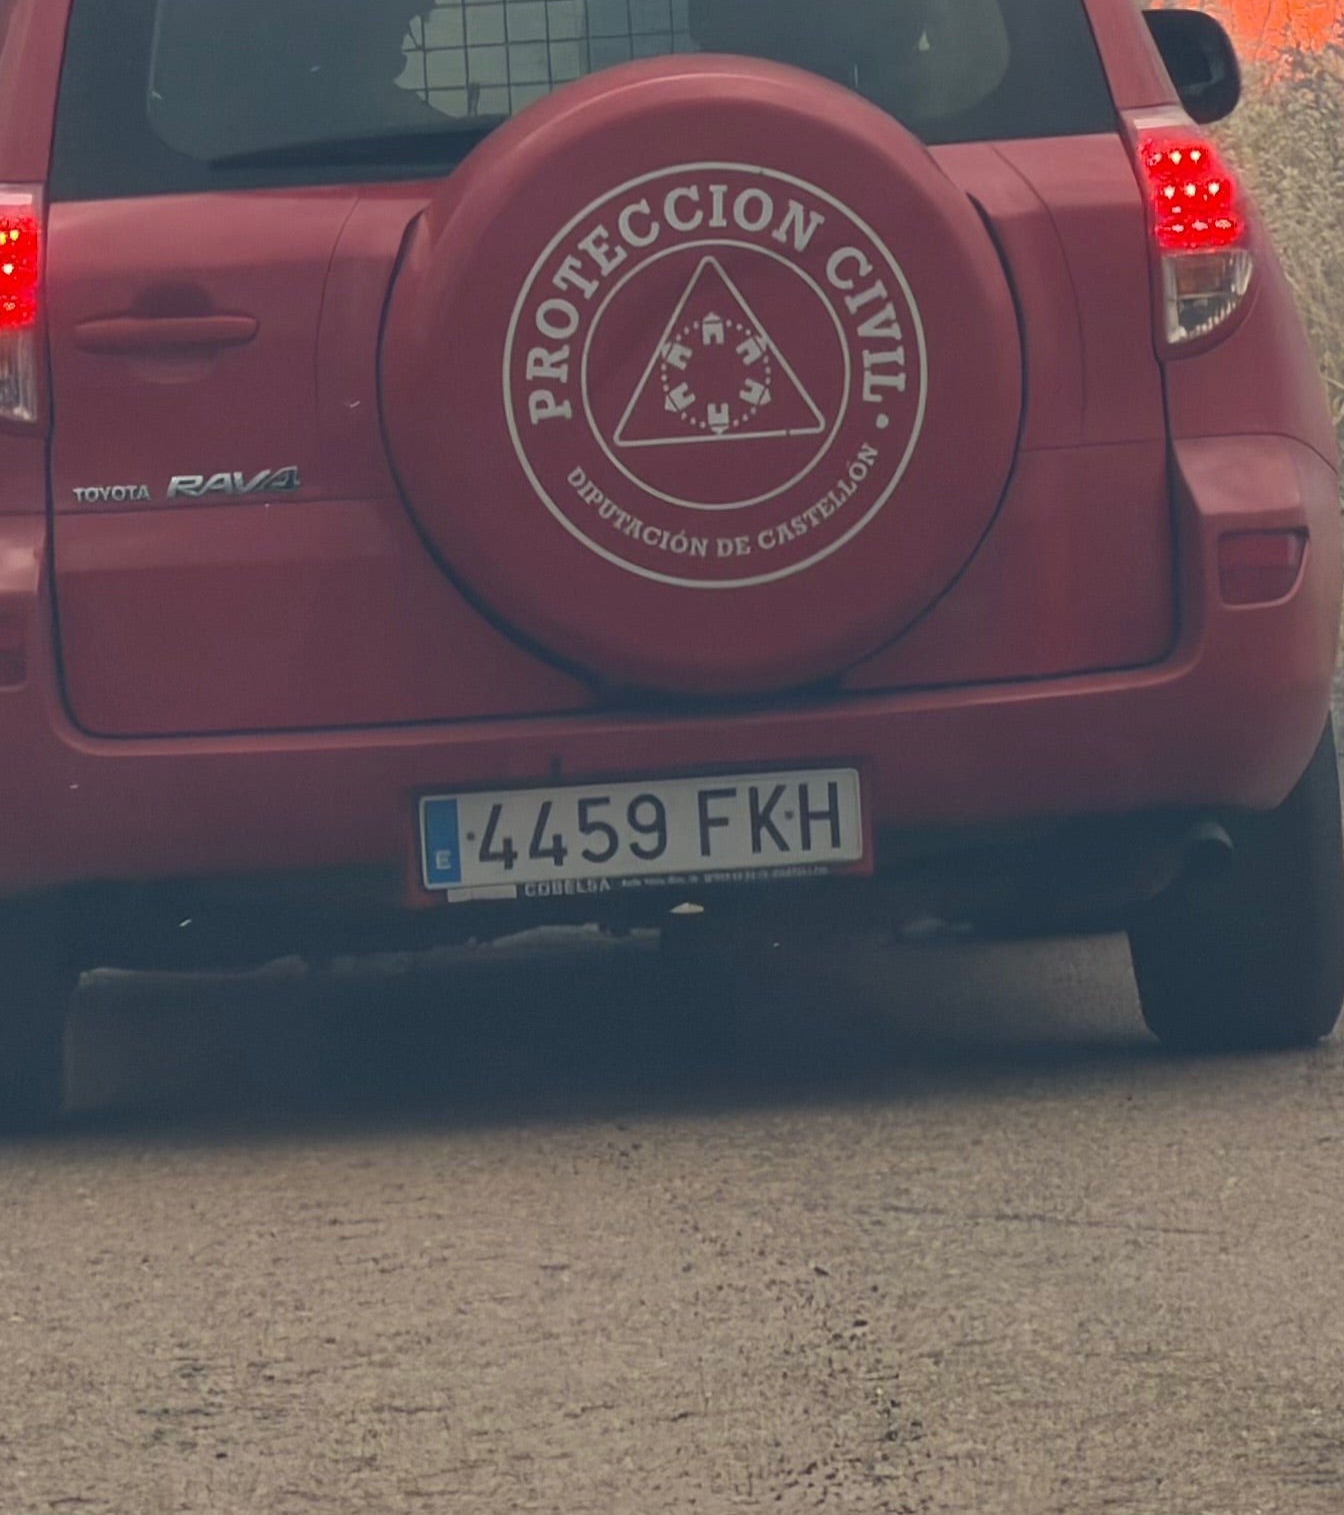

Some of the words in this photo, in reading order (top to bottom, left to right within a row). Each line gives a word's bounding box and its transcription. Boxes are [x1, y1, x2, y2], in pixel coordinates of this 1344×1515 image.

[525, 184, 825, 425] PROTECCION
[825, 245, 906, 403] CIVIL
[72, 484, 152, 502] TOYOTA
[166, 465, 301, 499] RAV4
[566, 466, 708, 558] DIPUTACIÓN
[716, 537, 751, 558] DE
[435, 849, 452, 870] E
[477, 793, 669, 871] 4459
[696, 781, 842, 858] FKH
